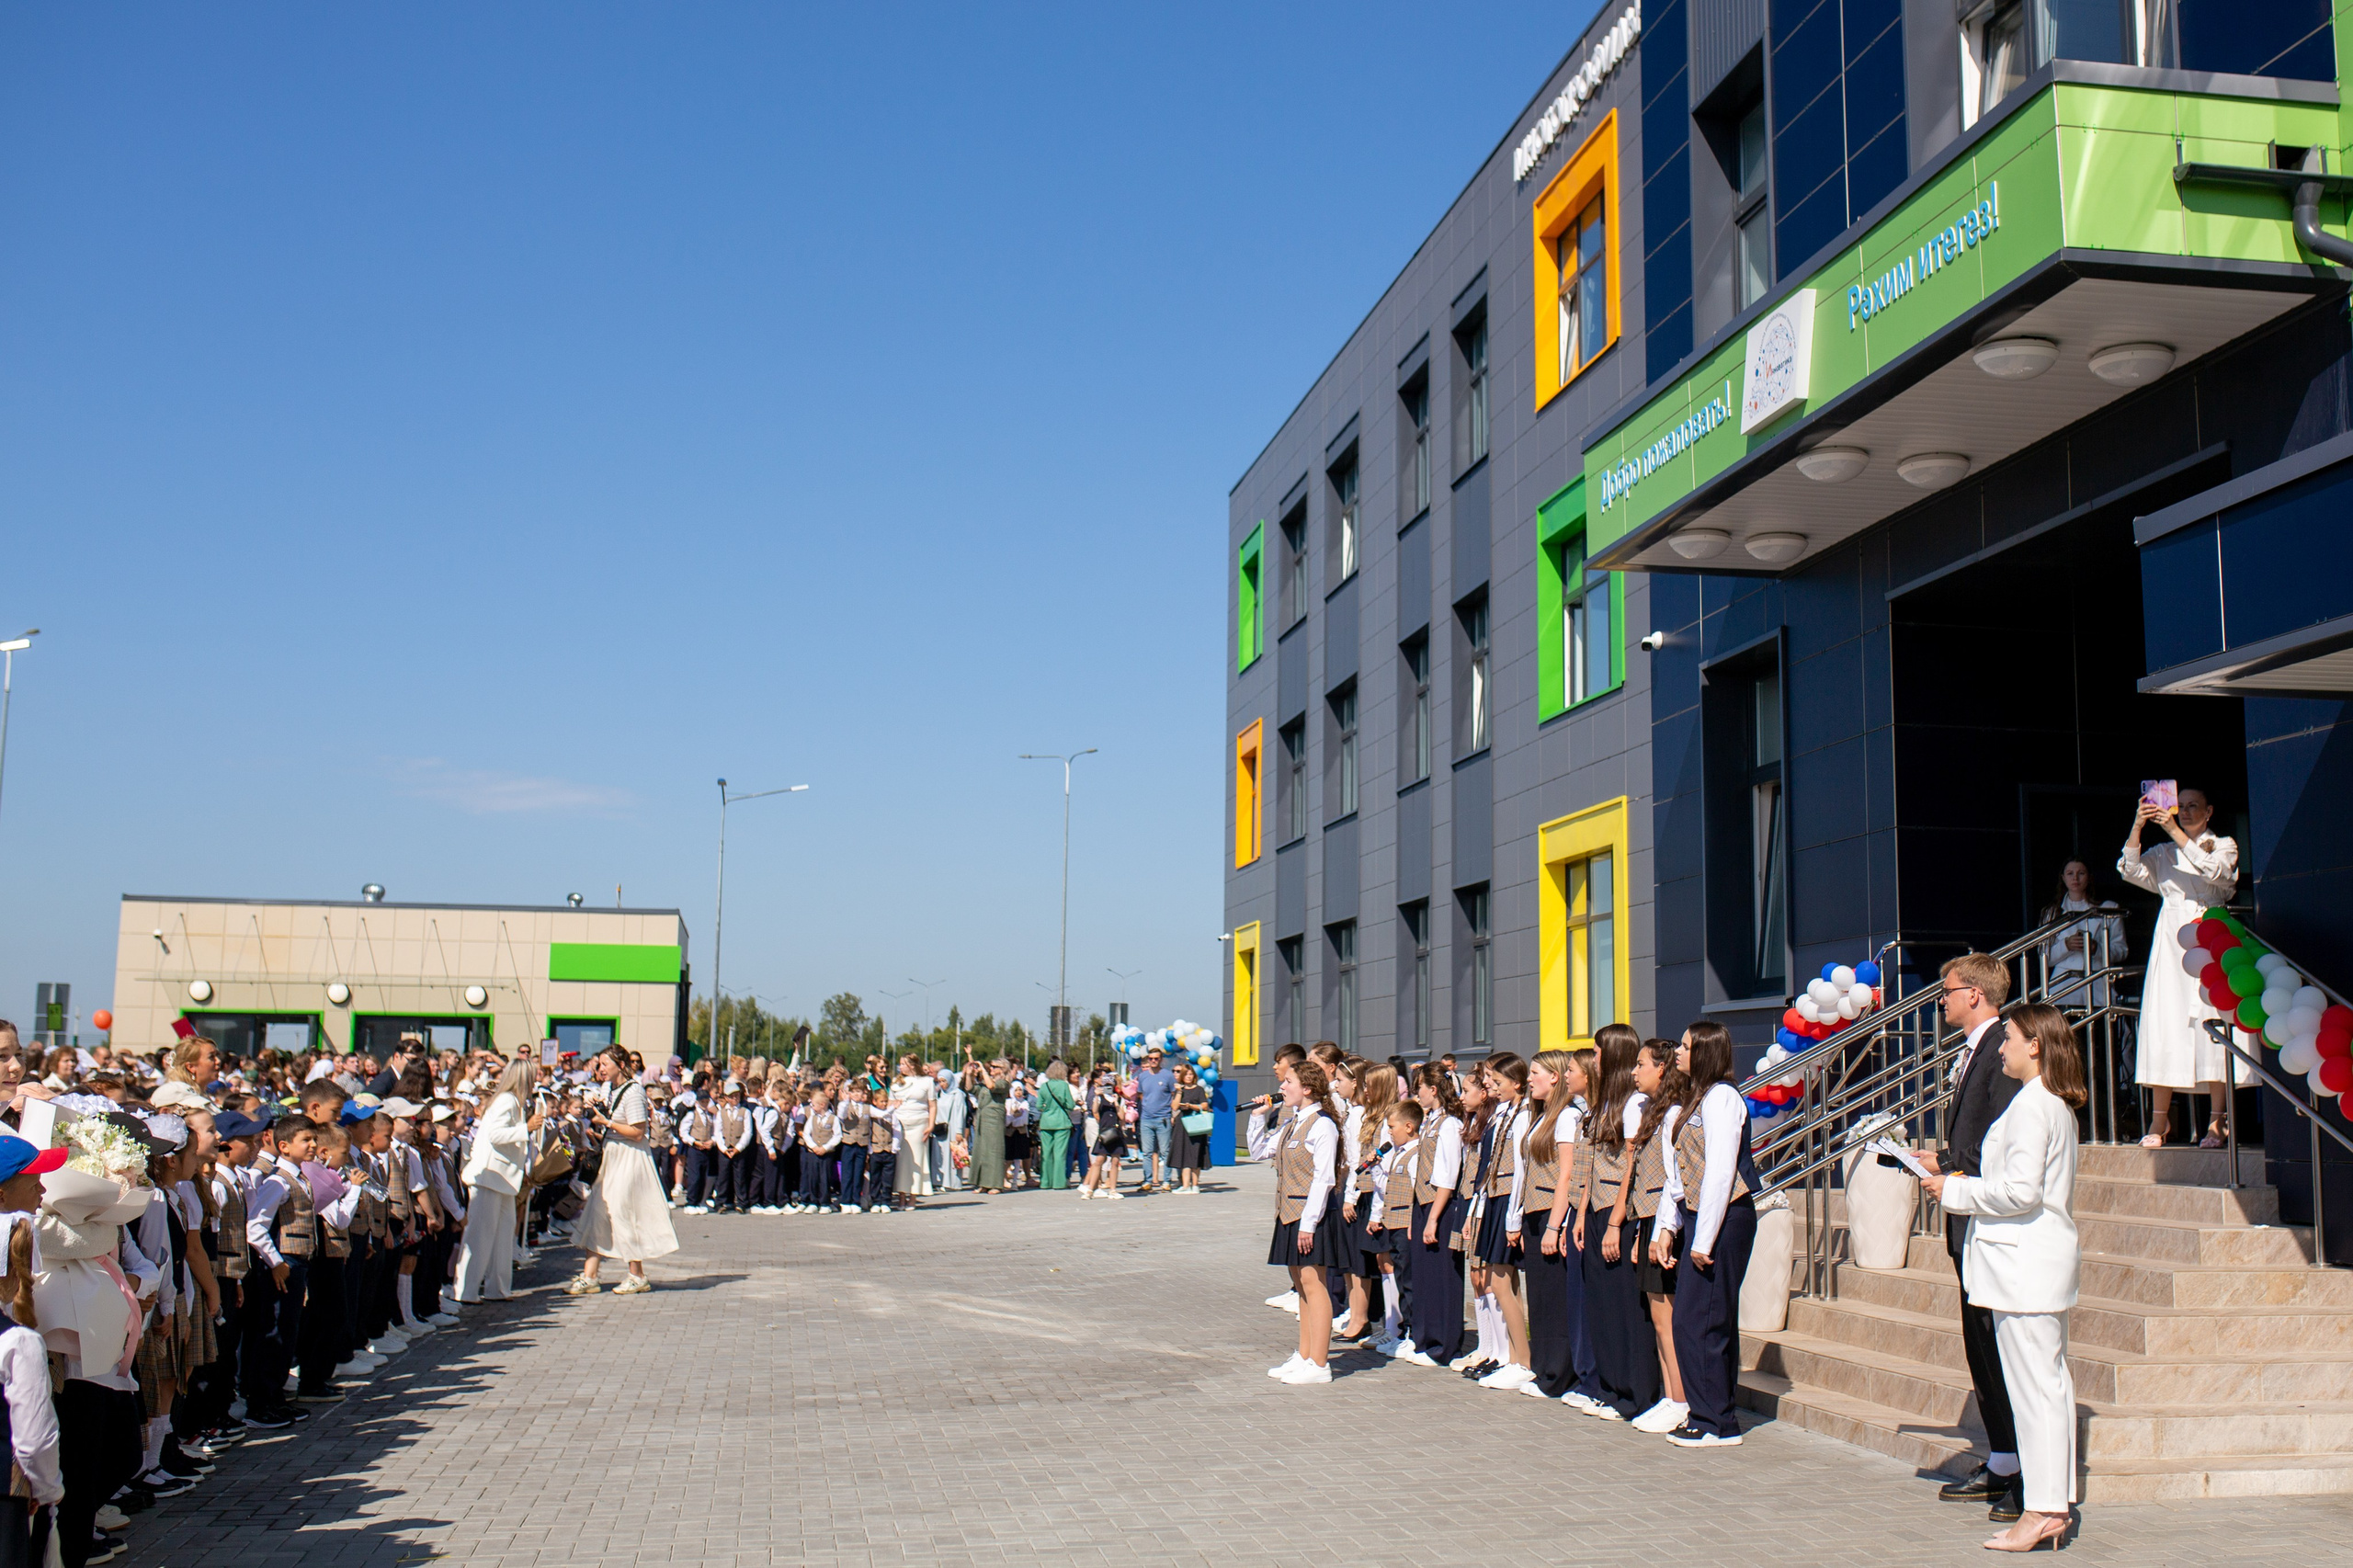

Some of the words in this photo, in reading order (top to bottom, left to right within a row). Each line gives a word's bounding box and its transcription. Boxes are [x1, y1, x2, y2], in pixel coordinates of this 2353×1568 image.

[1847, 256, 1914, 330] Рәхим
[1917, 180, 1999, 281] итегез!
[1600, 458, 1641, 513] Добро
[1642, 380, 1732, 477] пожаловать!
